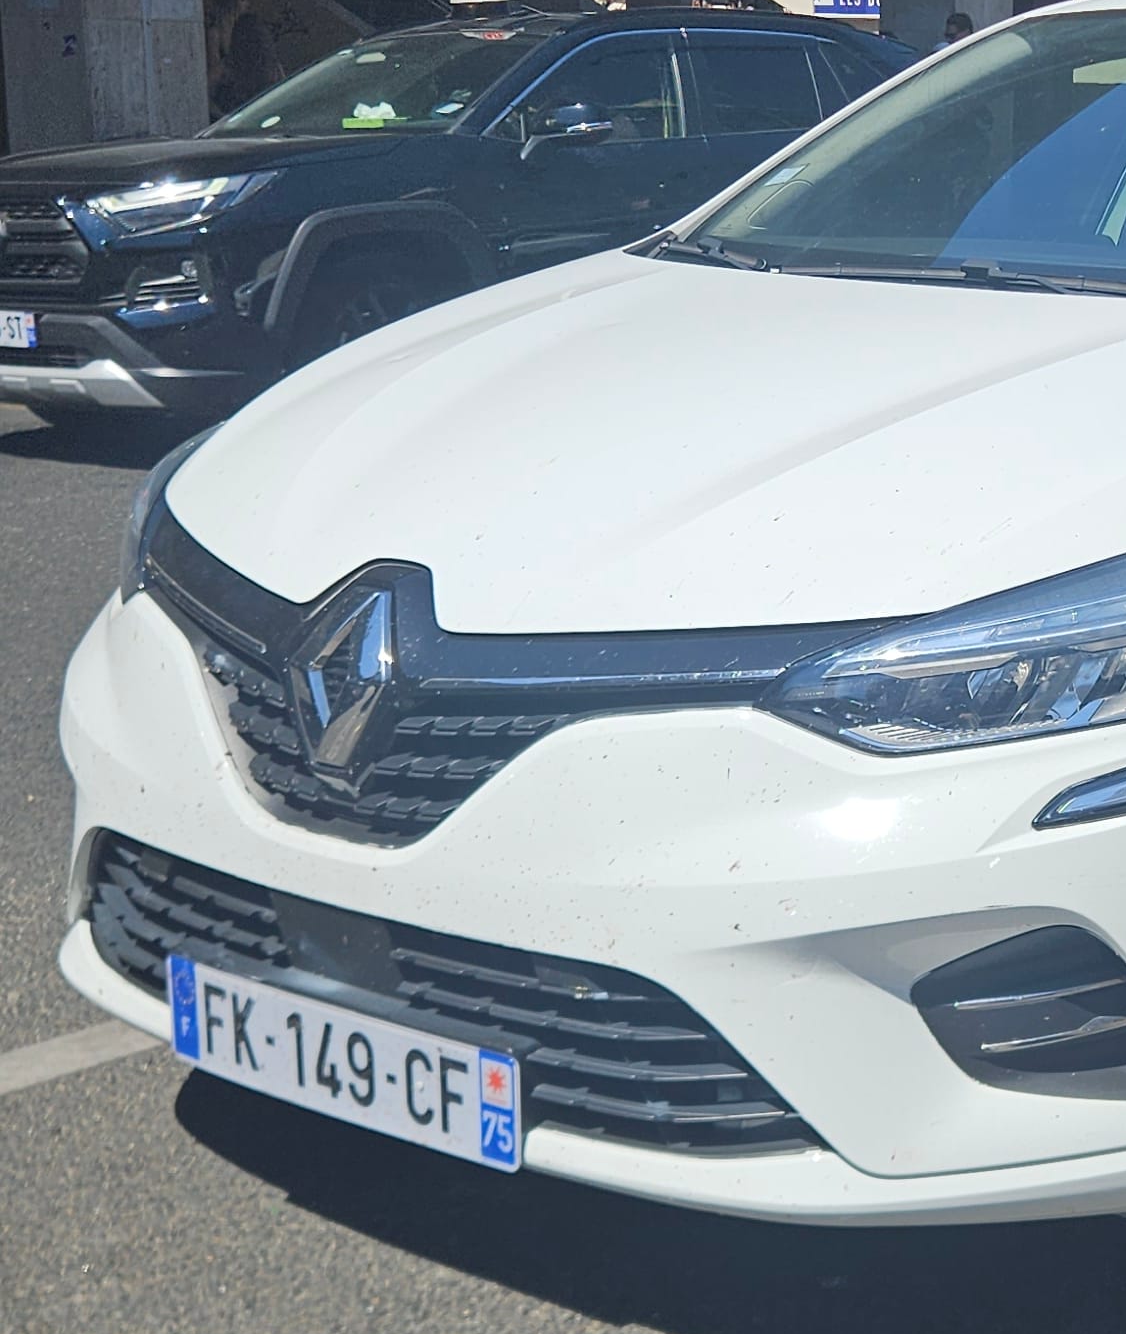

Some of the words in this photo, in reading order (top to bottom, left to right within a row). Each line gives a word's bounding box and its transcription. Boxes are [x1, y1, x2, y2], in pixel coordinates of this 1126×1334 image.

[180, 1015, 191, 1038] F
[203, 981, 469, 1134] FK-149-CF
[482, 1111, 515, 1154] 75
